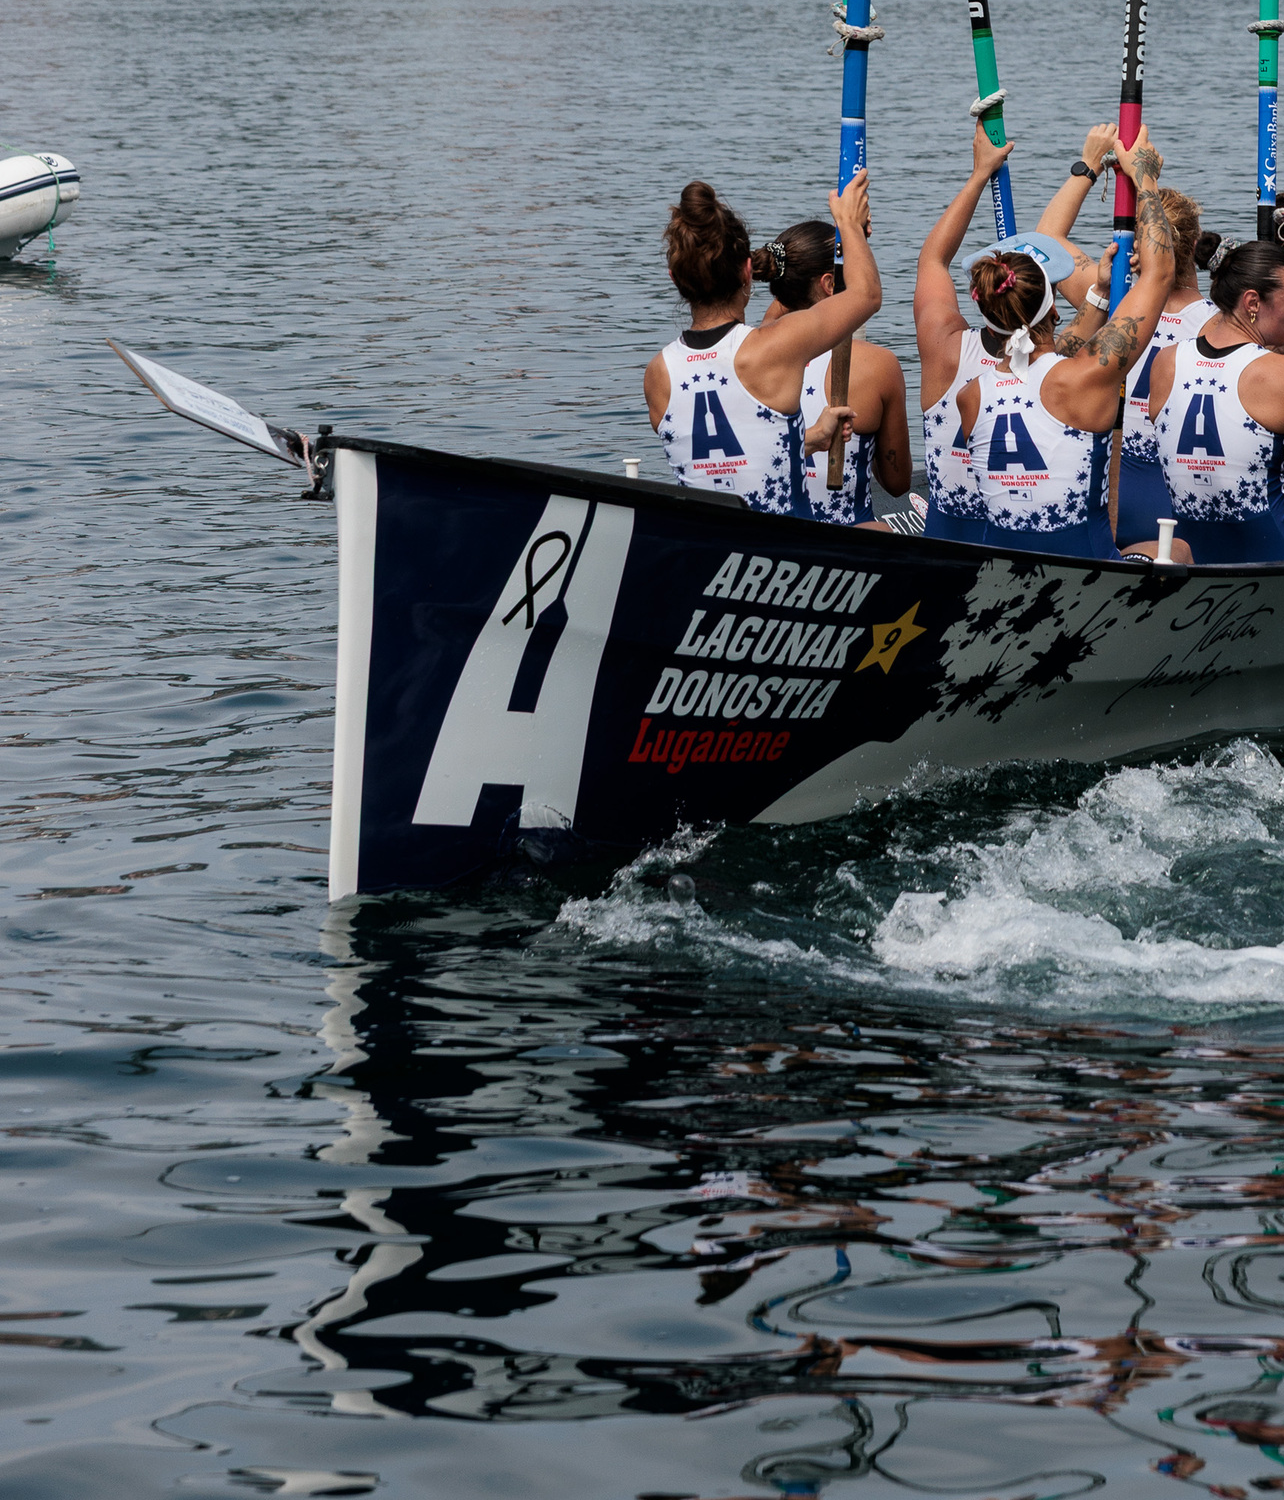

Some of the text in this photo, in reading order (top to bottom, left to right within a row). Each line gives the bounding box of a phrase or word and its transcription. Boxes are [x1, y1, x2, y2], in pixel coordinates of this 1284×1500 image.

[1265, 101, 1279, 171] CaixaBank
[687, 351, 717, 362] amura
[1196, 360, 1225, 368] amura
[693, 459, 748, 470] ARRAUN LAGUNAK
[706, 468, 738, 476] DONOSTIA
[702, 552, 882, 614] ARRAUN
[412, 494, 635, 828] A
[674, 609, 865, 669] LAGUNAK
[879, 627, 902, 654] 9
[644, 667, 841, 719] DONOSTIA
[628, 718, 791, 774] Lugañene
